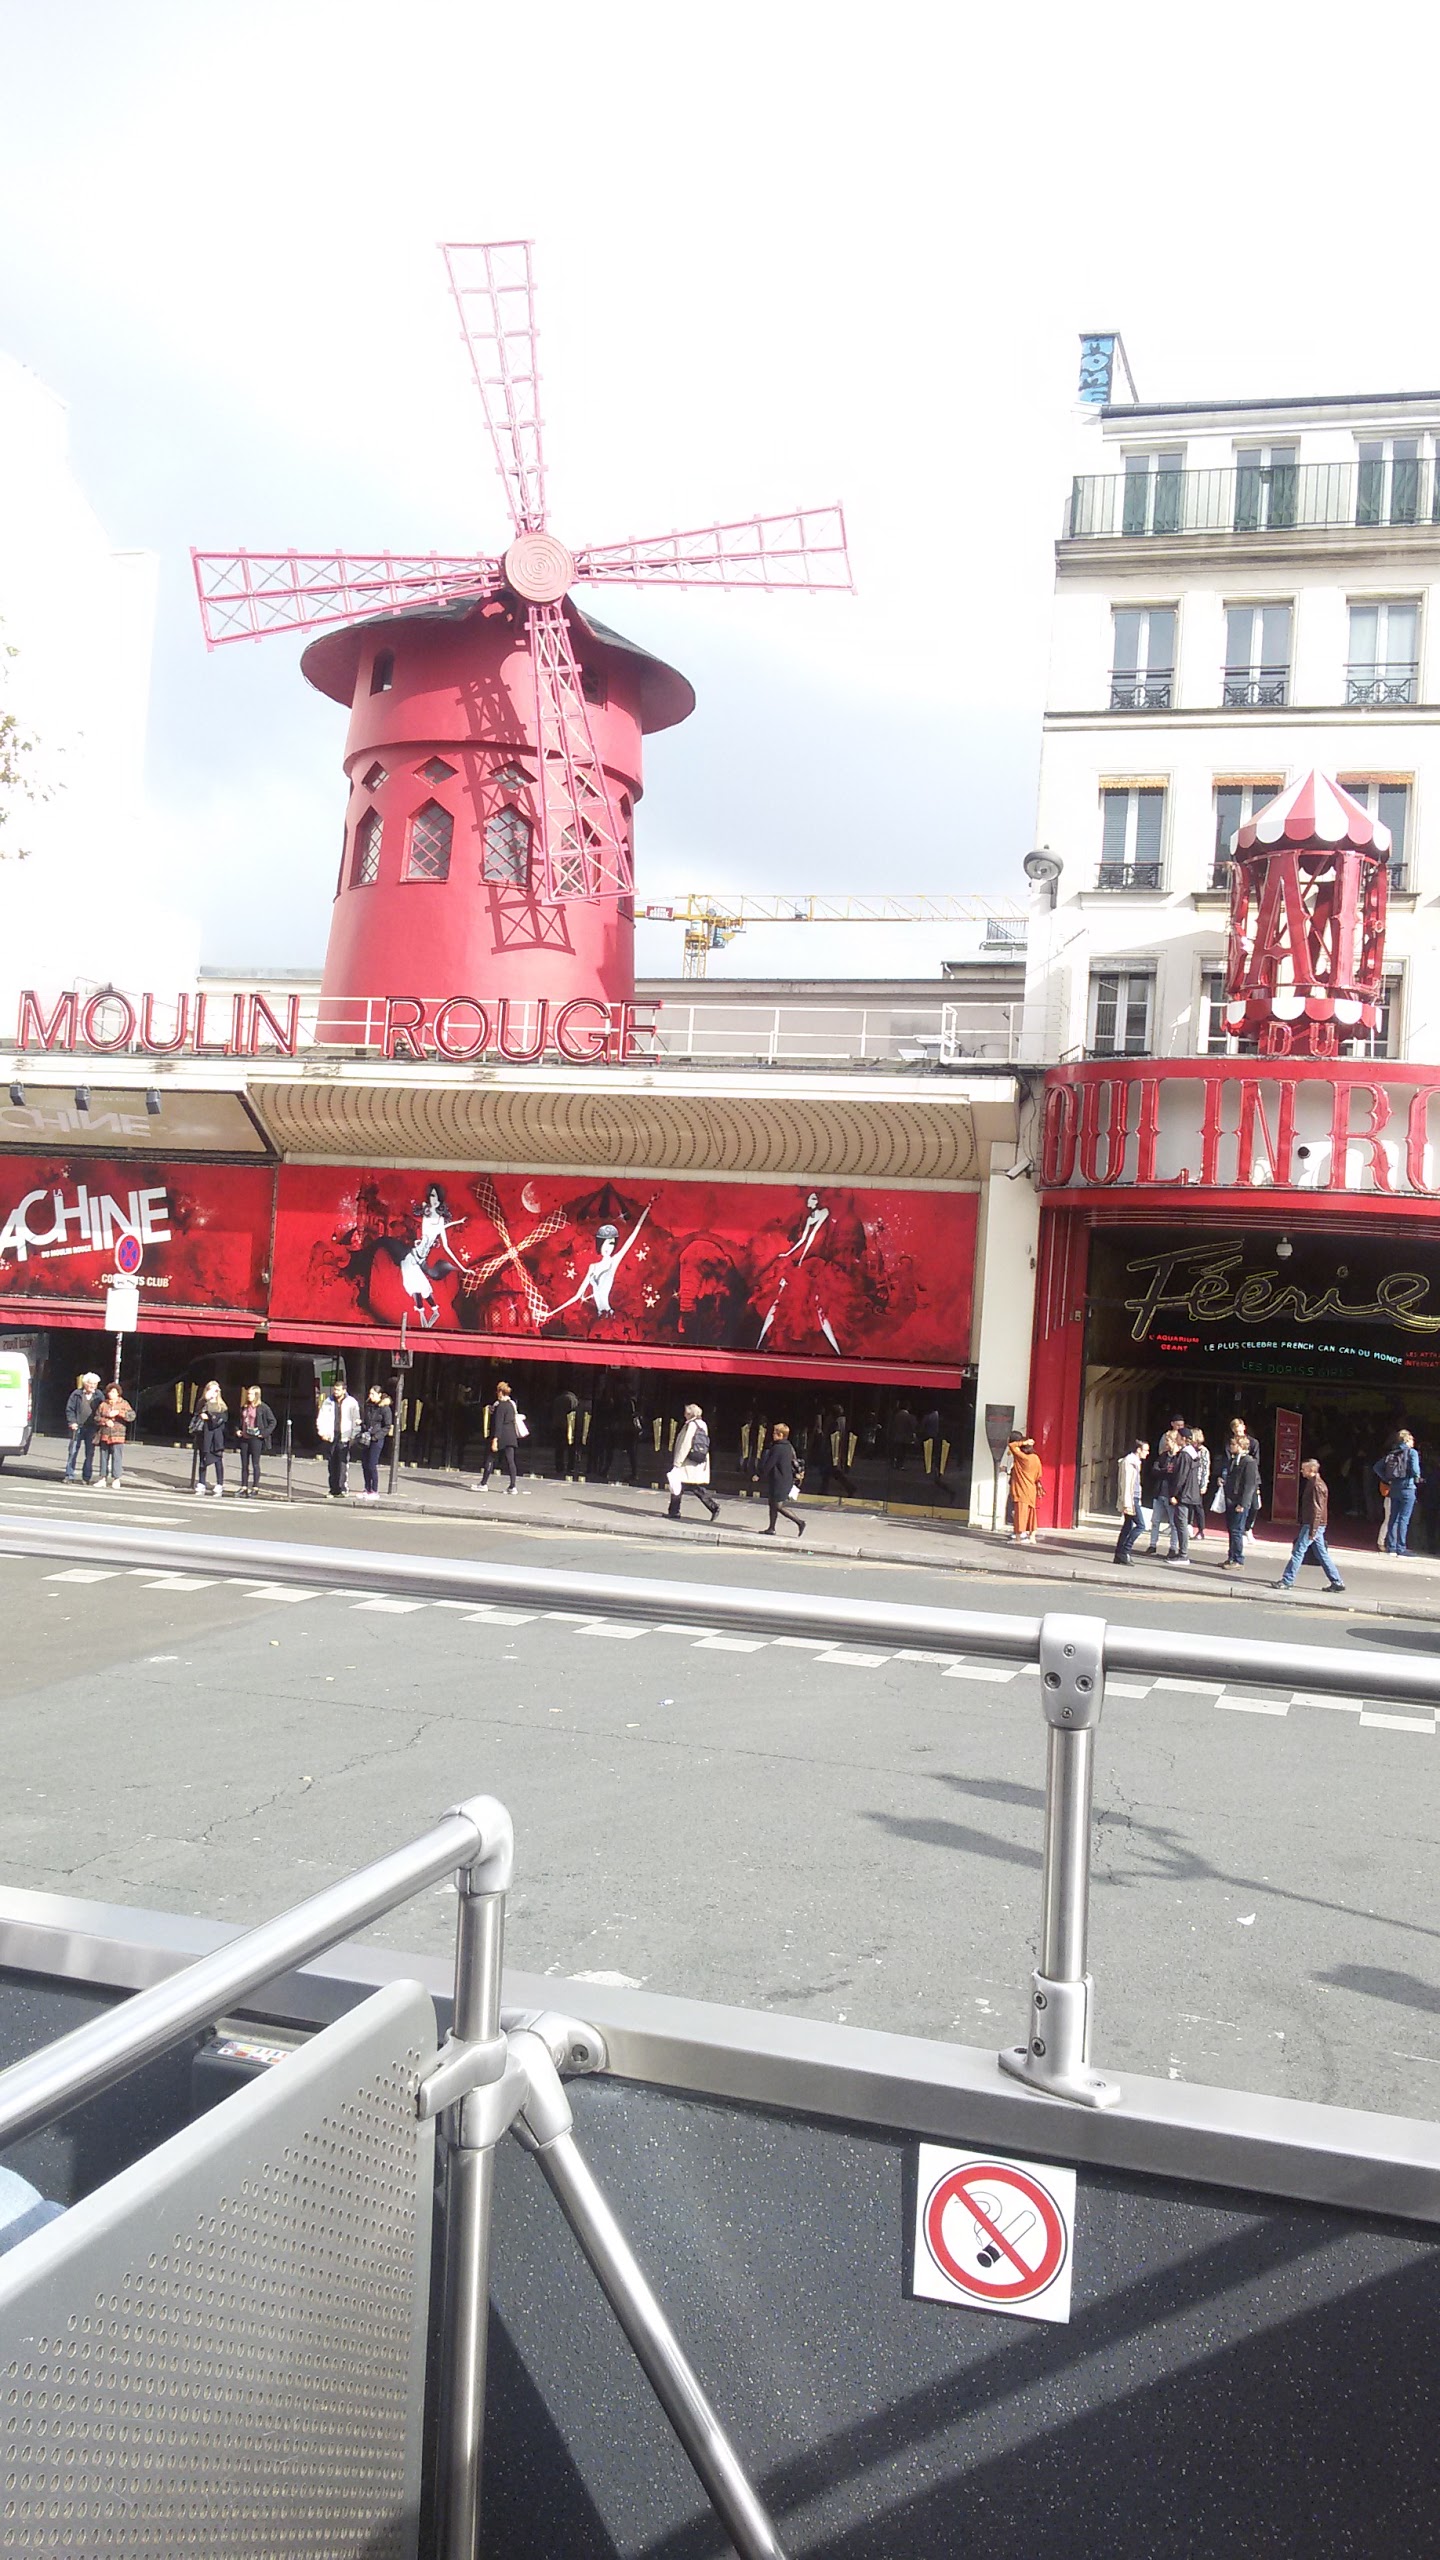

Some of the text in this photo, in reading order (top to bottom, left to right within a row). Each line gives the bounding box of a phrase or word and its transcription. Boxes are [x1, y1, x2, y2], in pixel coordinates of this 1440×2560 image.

[16, 990, 665, 1064] MOULIN ROUGE
[1268, 1020, 1336, 1057] DU
[146, 1276, 170, 1288] CLUB
[1204, 1343, 1215, 1352] LE
[1217, 1341, 1240, 1351] PLUS
[1280, 1341, 1314, 1350] FRENCH
[1317, 1344, 1336, 1352] CAN
[1373, 1351, 1404, 1366] MONDE
